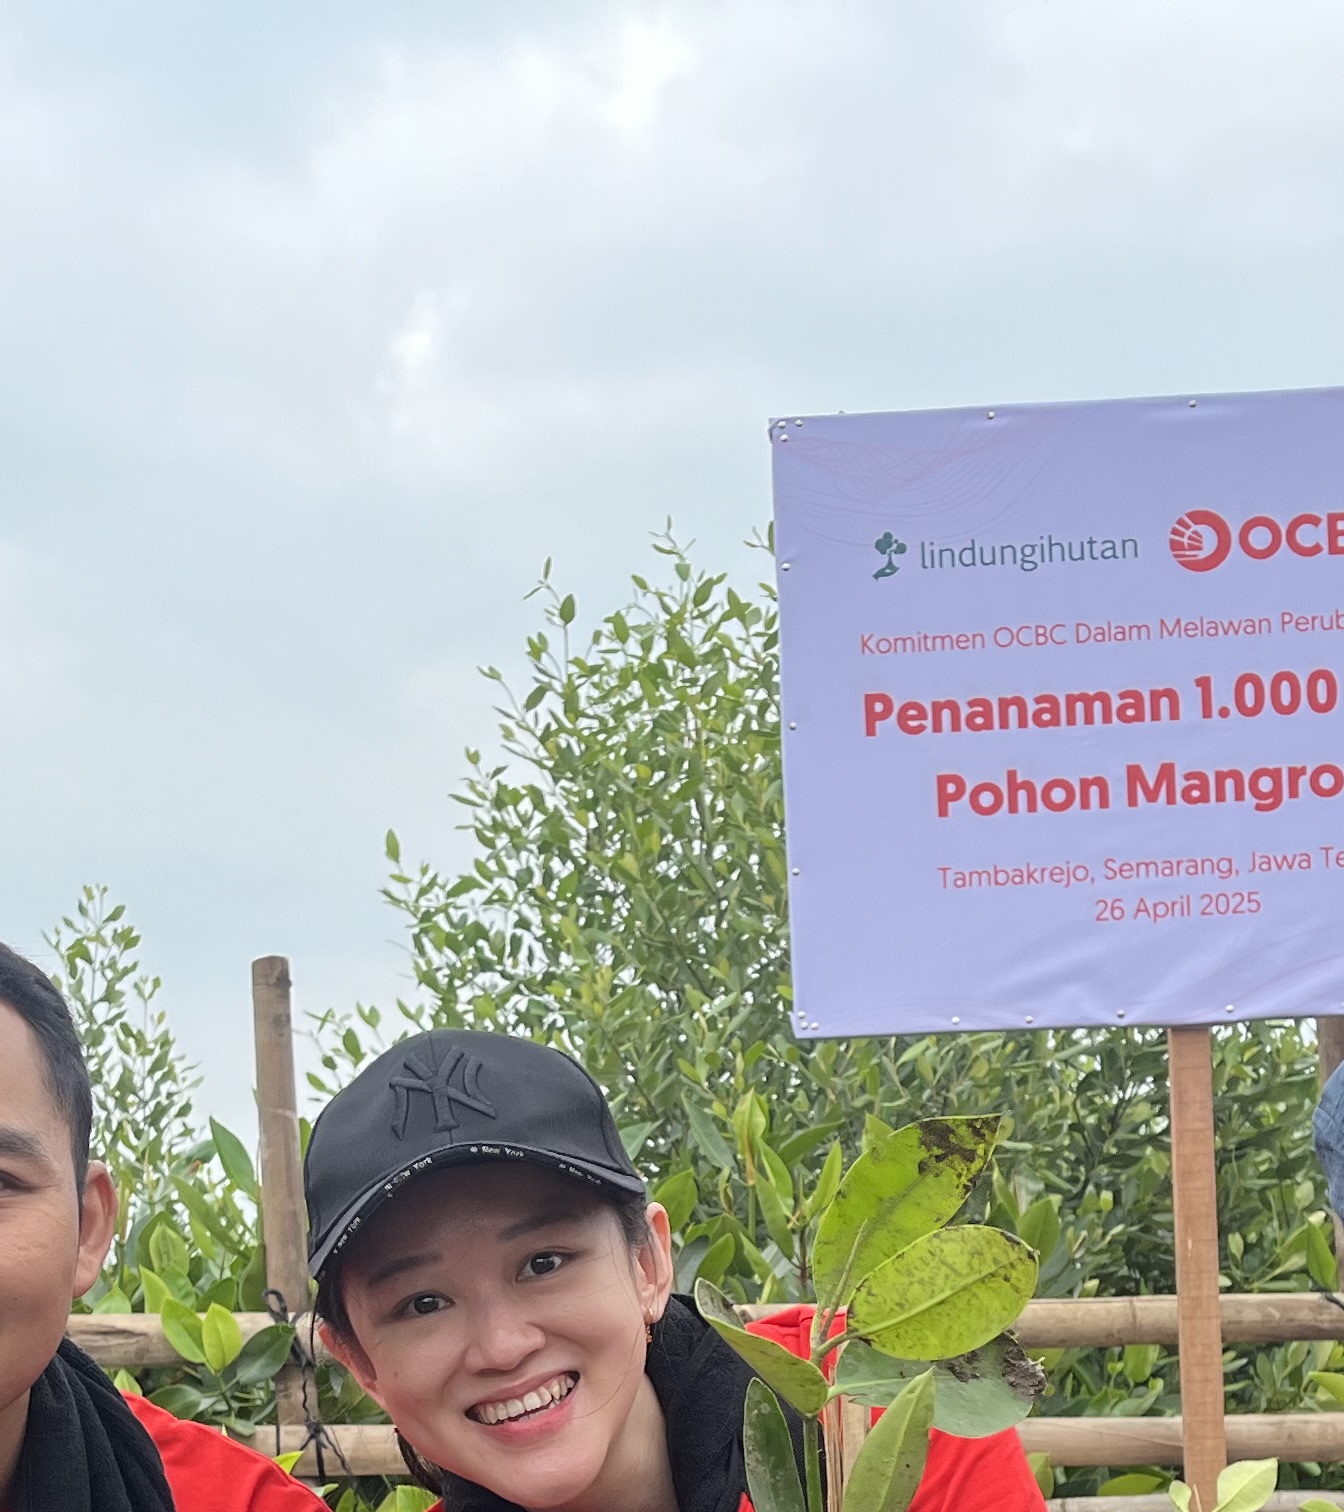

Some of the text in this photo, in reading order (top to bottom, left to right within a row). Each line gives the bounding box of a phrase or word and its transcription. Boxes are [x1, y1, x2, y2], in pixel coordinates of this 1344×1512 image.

[919, 534, 1140, 572] lindungihutan
[859, 630, 986, 655] Komitmen
[993, 623, 1068, 648] OCBC
[1075, 620, 1151, 644] Dalam
[1159, 616, 1272, 640] Melawan
[863, 681, 1182, 738] Penanaman
[1193, 668, 1339, 721] 1.000
[935, 768, 1112, 819] Pohon
[937, 861, 1096, 890] Tambakrejo,
[1103, 855, 1241, 881] Semarang,
[1247, 850, 1312, 874] Jawa
[1094, 891, 1262, 924] 26 April 2025
